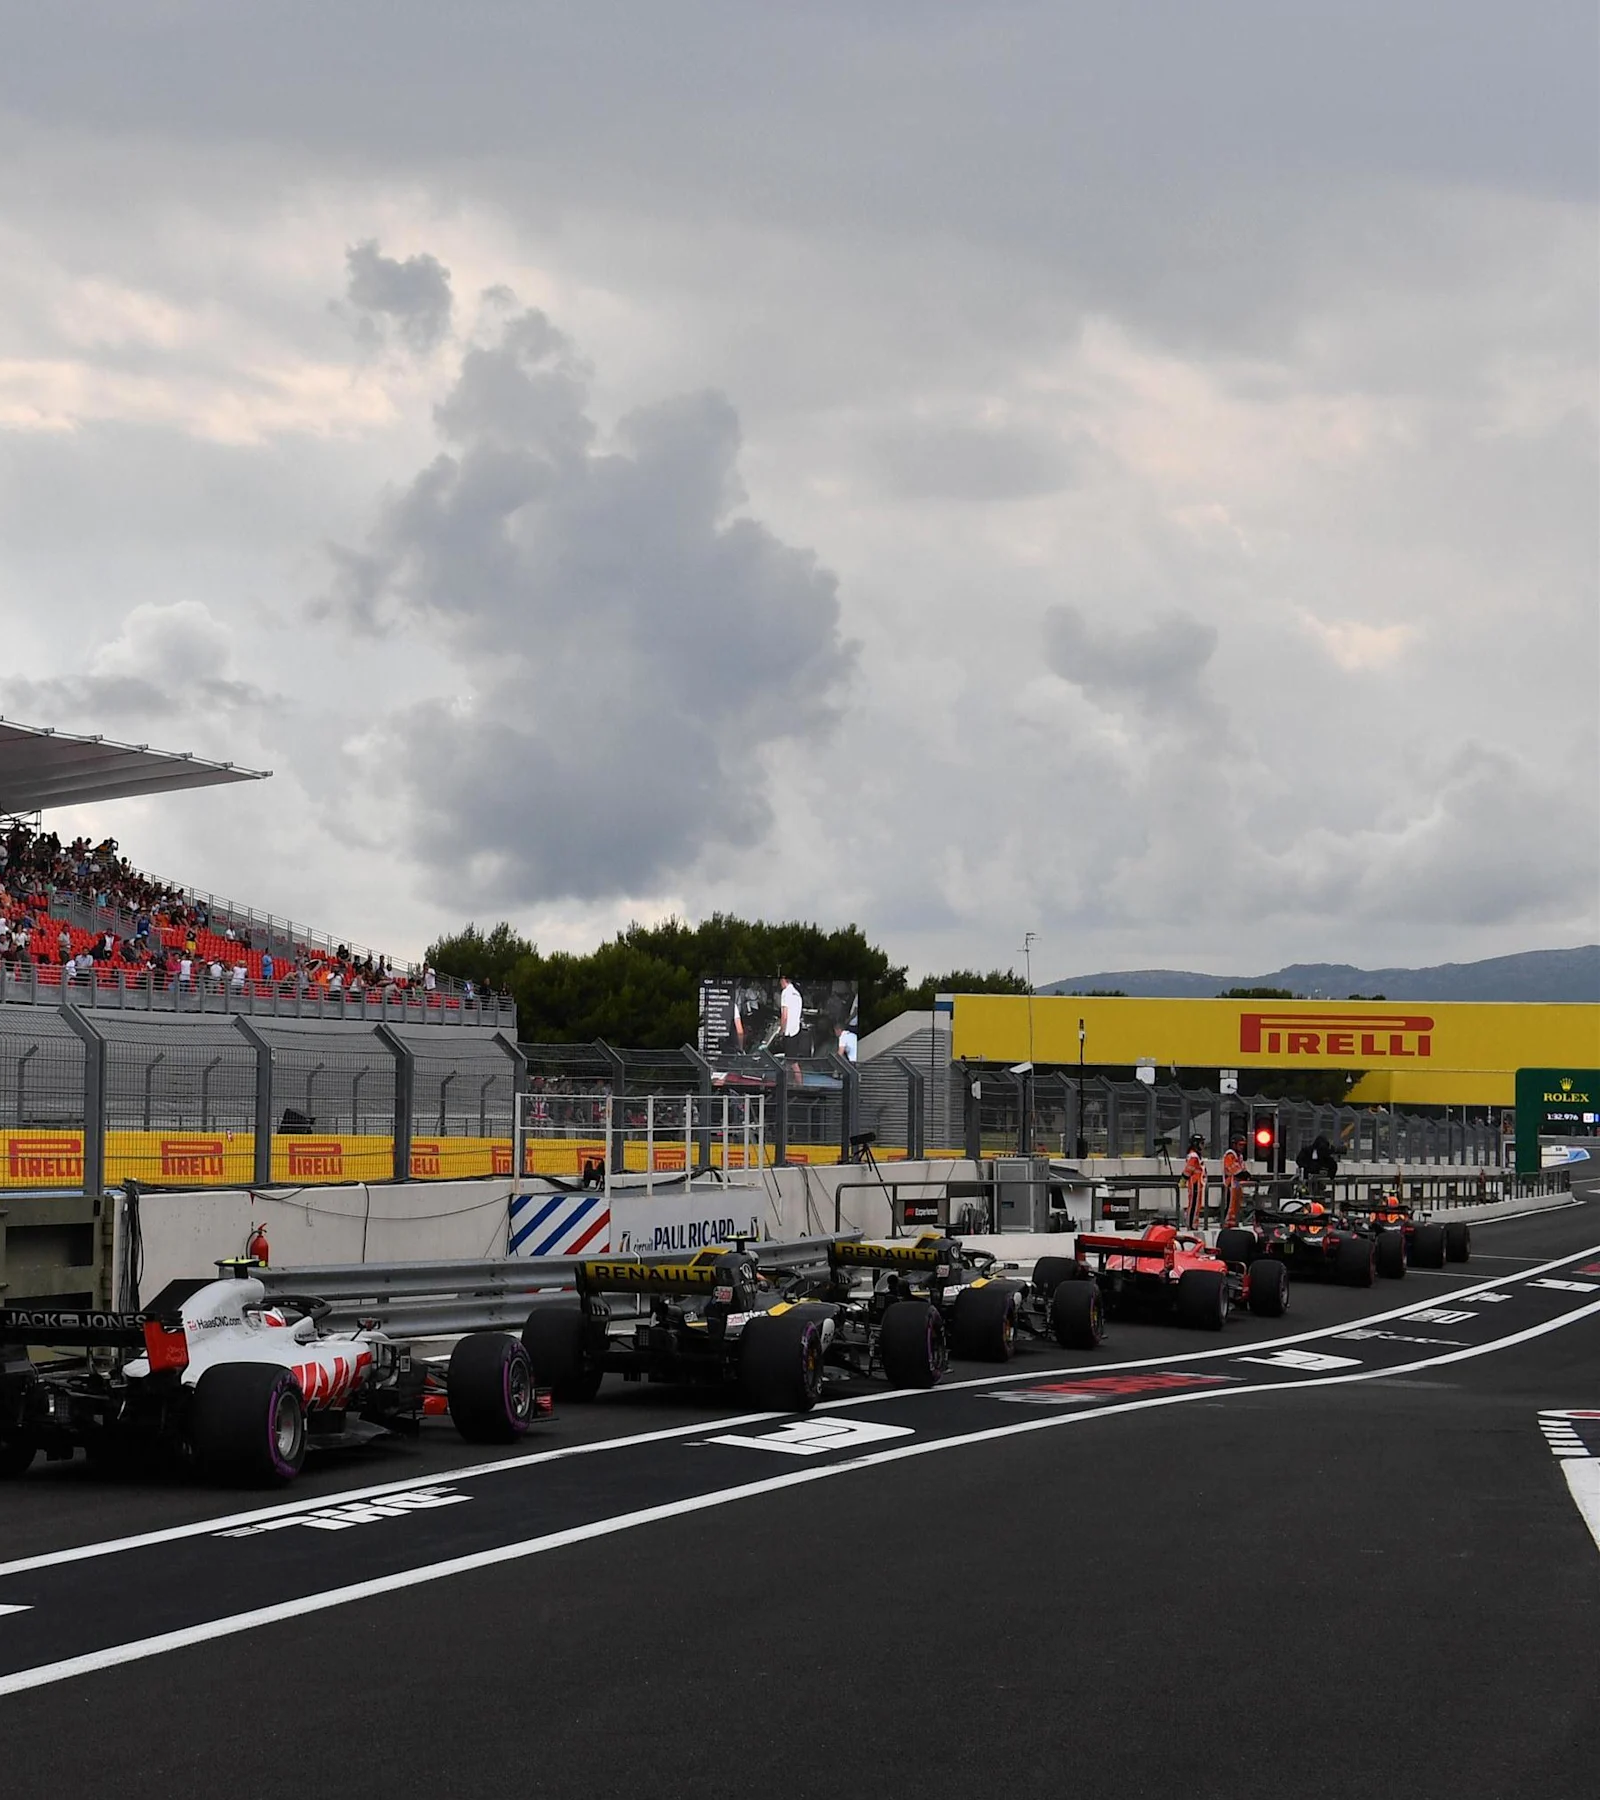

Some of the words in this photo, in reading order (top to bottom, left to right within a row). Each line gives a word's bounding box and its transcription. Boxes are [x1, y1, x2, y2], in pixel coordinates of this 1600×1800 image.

[1239, 1013, 1435, 1057] PIRELLI
[1543, 1092, 1590, 1102] ROLEX
[1546, 1112, 1579, 1121] 1:32.976
[8, 1139, 82, 1177] PIRELLI
[161, 1141, 224, 1176] PIRELLI
[288, 1143, 343, 1175] PIRELLI
[654, 1224, 687, 1250] PAUL
[688, 1218, 736, 1248] RICARD
[842, 1246, 932, 1262] RENAULT
[595, 1265, 708, 1282] RENAULT
[6, 1312, 60, 1327] JACK
[77, 1313, 147, 1329] JONES
[197, 1315, 243, 1330] HaasCNC.com
